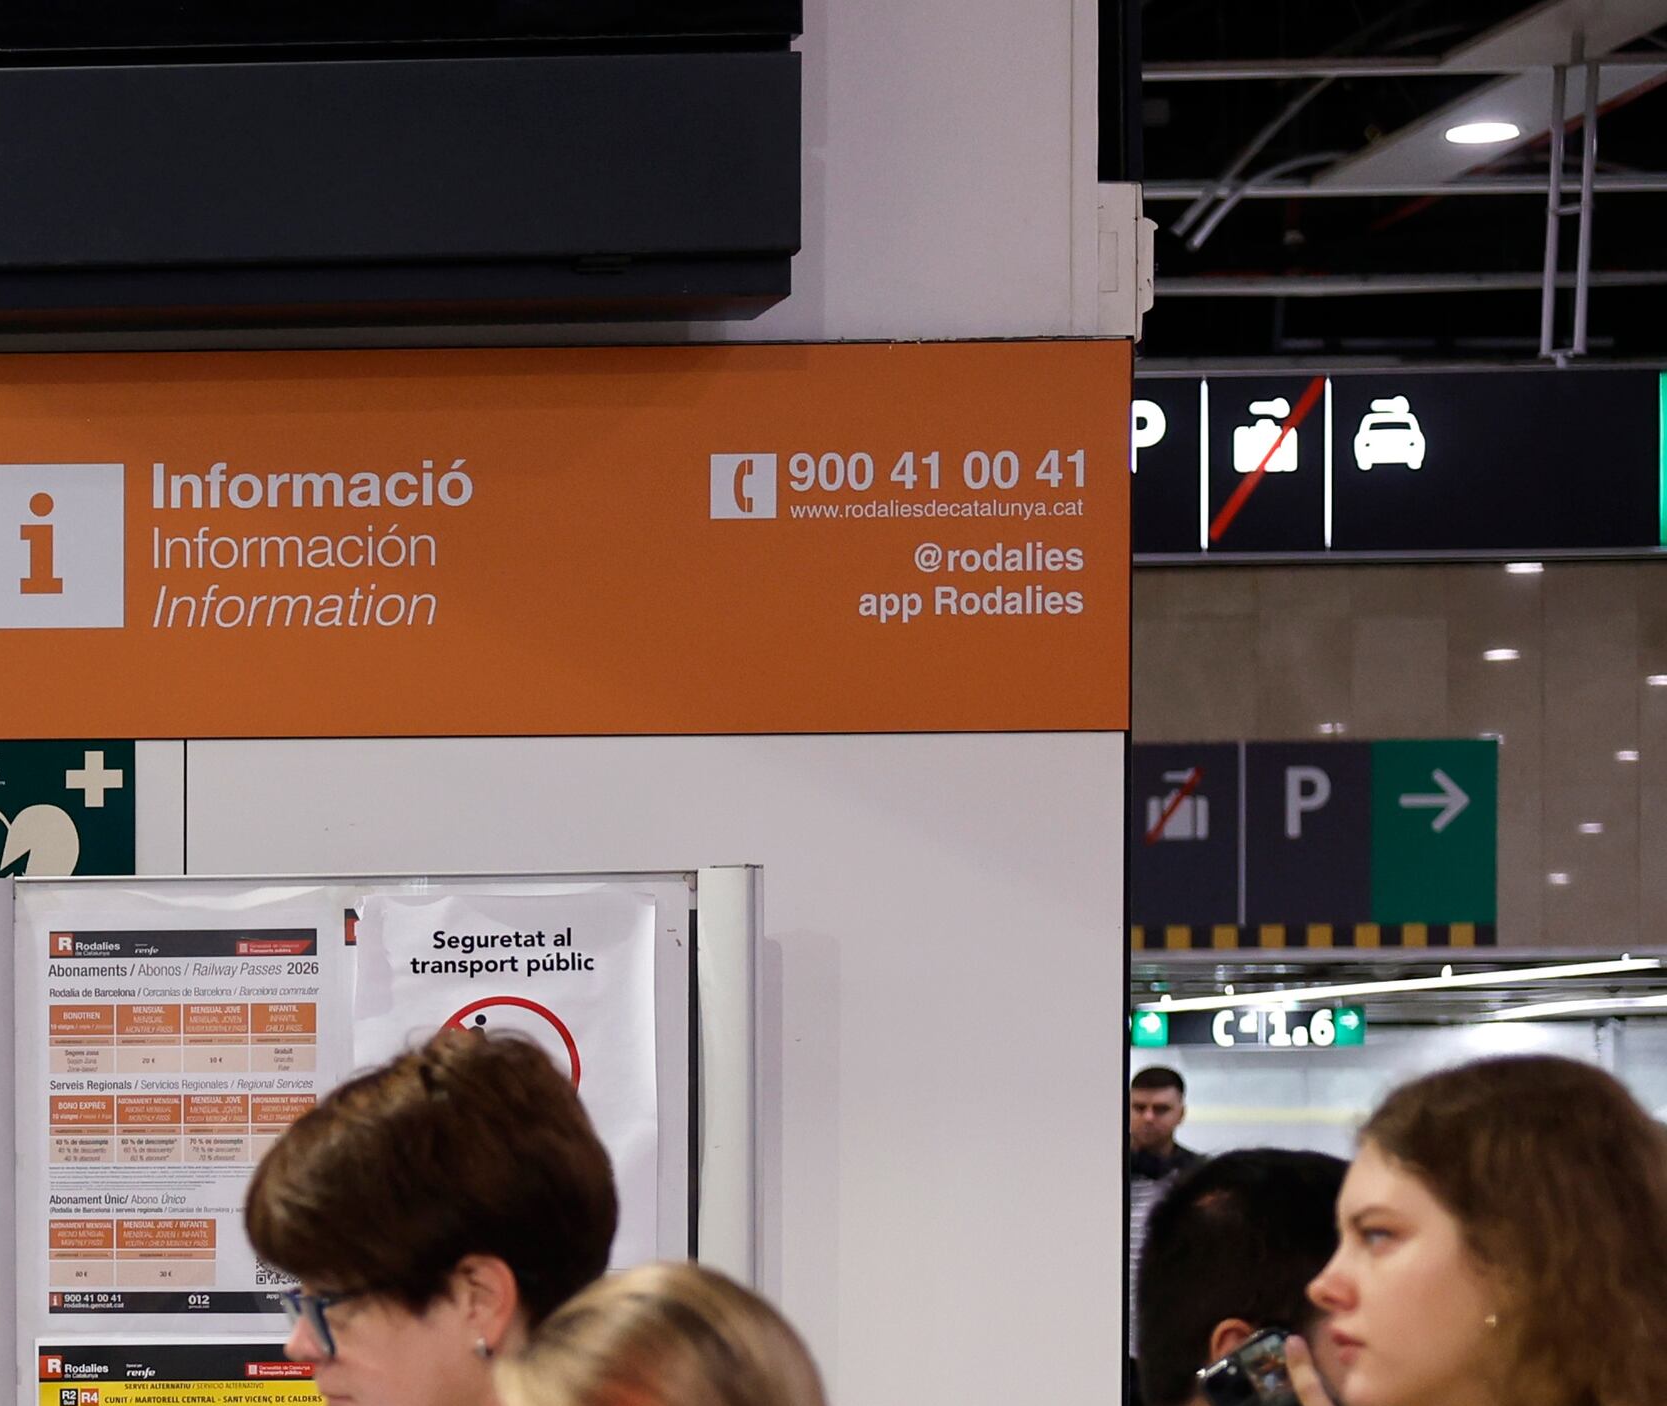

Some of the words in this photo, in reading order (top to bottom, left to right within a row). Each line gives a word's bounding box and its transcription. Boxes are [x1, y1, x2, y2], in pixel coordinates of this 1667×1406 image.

[788, 452, 874, 492] 900
[889, 451, 940, 490] 41
[963, 450, 1020, 490] 00
[1035, 449, 1086, 488] 41
[152, 459, 474, 510] Informació
[789, 499, 1084, 521] www.rodaliesdecatalunya.cat
[153, 523, 437, 569] Información
[913, 541, 1084, 573] @rodalies
[152, 583, 437, 628] Information
[858, 591, 923, 624] app
[934, 584, 1084, 616] Rodalies
[1285, 765, 1332, 839] P
[75, 941, 121, 952] Rodalies
[432, 930, 546, 954] Seguretat
[553, 927, 572, 948] al
[134, 944, 160, 957] renfe
[48, 963, 128, 978] Abonaments
[137, 963, 182, 977] Abonos
[192, 962, 238, 978] Railway
[239, 962, 282, 976] Passes
[286, 961, 319, 975] 2026
[410, 955, 519, 978] transport
[526, 952, 595, 977] públic
[49, 1080, 85, 1091] Serveis
[86, 1080, 133, 1092] Regionals
[140, 1079, 180, 1090] Servicios
[181, 1079, 229, 1091] Regionales
[236, 1079, 274, 1090] Regional
[275, 1078, 314, 1090] Services
[49, 1194, 102, 1205] Abonament
[131, 1194, 159, 1205] Abono
[160, 1192, 187, 1205] Único
[188, 1294, 211, 1305] 012
[47, 1358, 62, 1373] R
[64, 1363, 109, 1374] Rodalies
[126, 1367, 156, 1380] renfe
[61, 1390, 77, 1400] R2
[81, 1391, 99, 1403] R4
[104, 1396, 129, 1404] CUNIT
[134, 1395, 181, 1404] MARTORELL
[182, 1395, 216, 1404] CENTRAL
[223, 1395, 243, 1403] SANT
[245, 1395, 274, 1405] VICENÇ
[274, 1395, 285, 1403] DE
[286, 1394, 323, 1403] CALDERS
